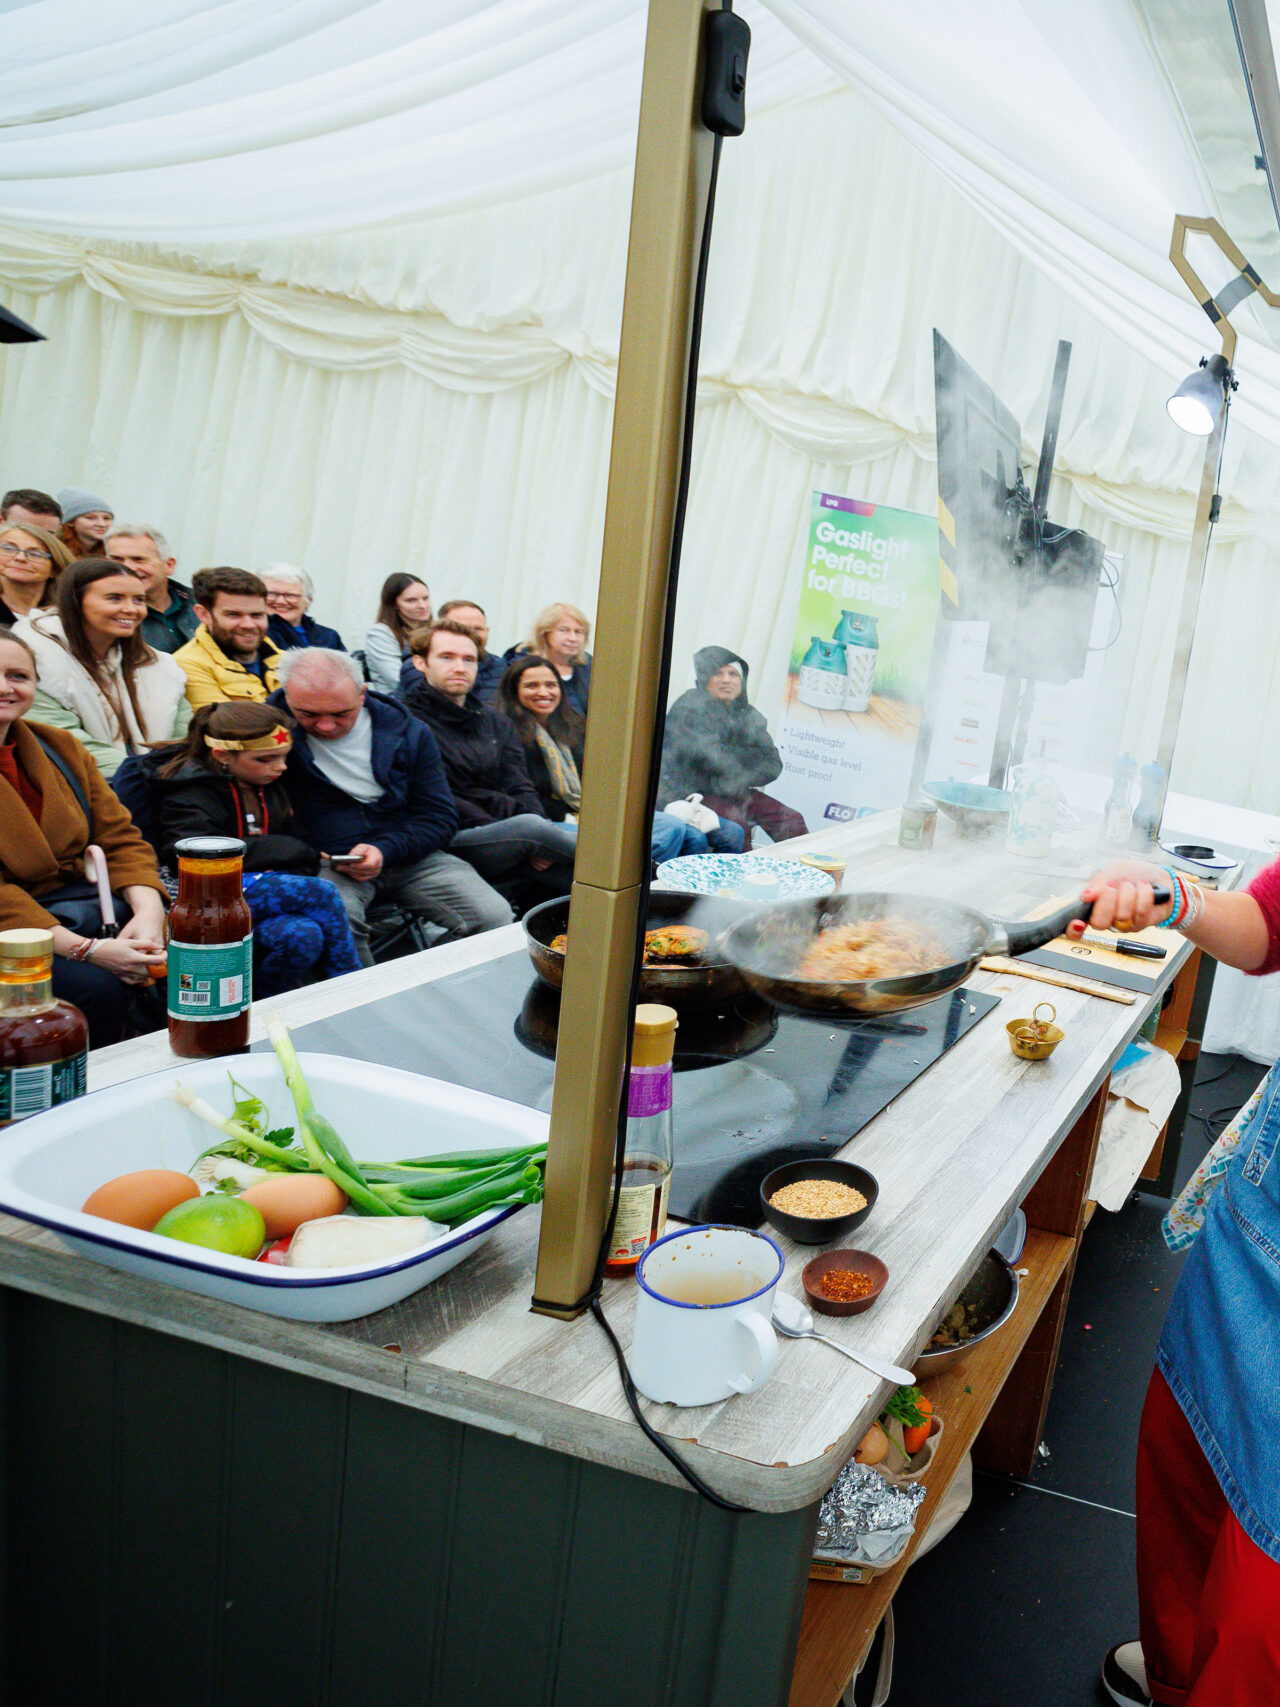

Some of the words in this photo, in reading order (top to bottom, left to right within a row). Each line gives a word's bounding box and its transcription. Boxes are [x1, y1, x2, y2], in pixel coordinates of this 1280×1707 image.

[816, 521, 910, 561] Gaslight
[812, 544, 891, 580] Perfect
[807, 569, 837, 593] for
[841, 575, 907, 611] BBQs!
[790, 727, 846, 749] Lightweight
[788, 744, 819, 761] Visible
[821, 755, 838, 766] gas
[840, 757, 862, 771] level
[785, 762, 806, 775] Rust
[808, 769, 833, 782] proof
[828, 806, 851, 819] FLO
